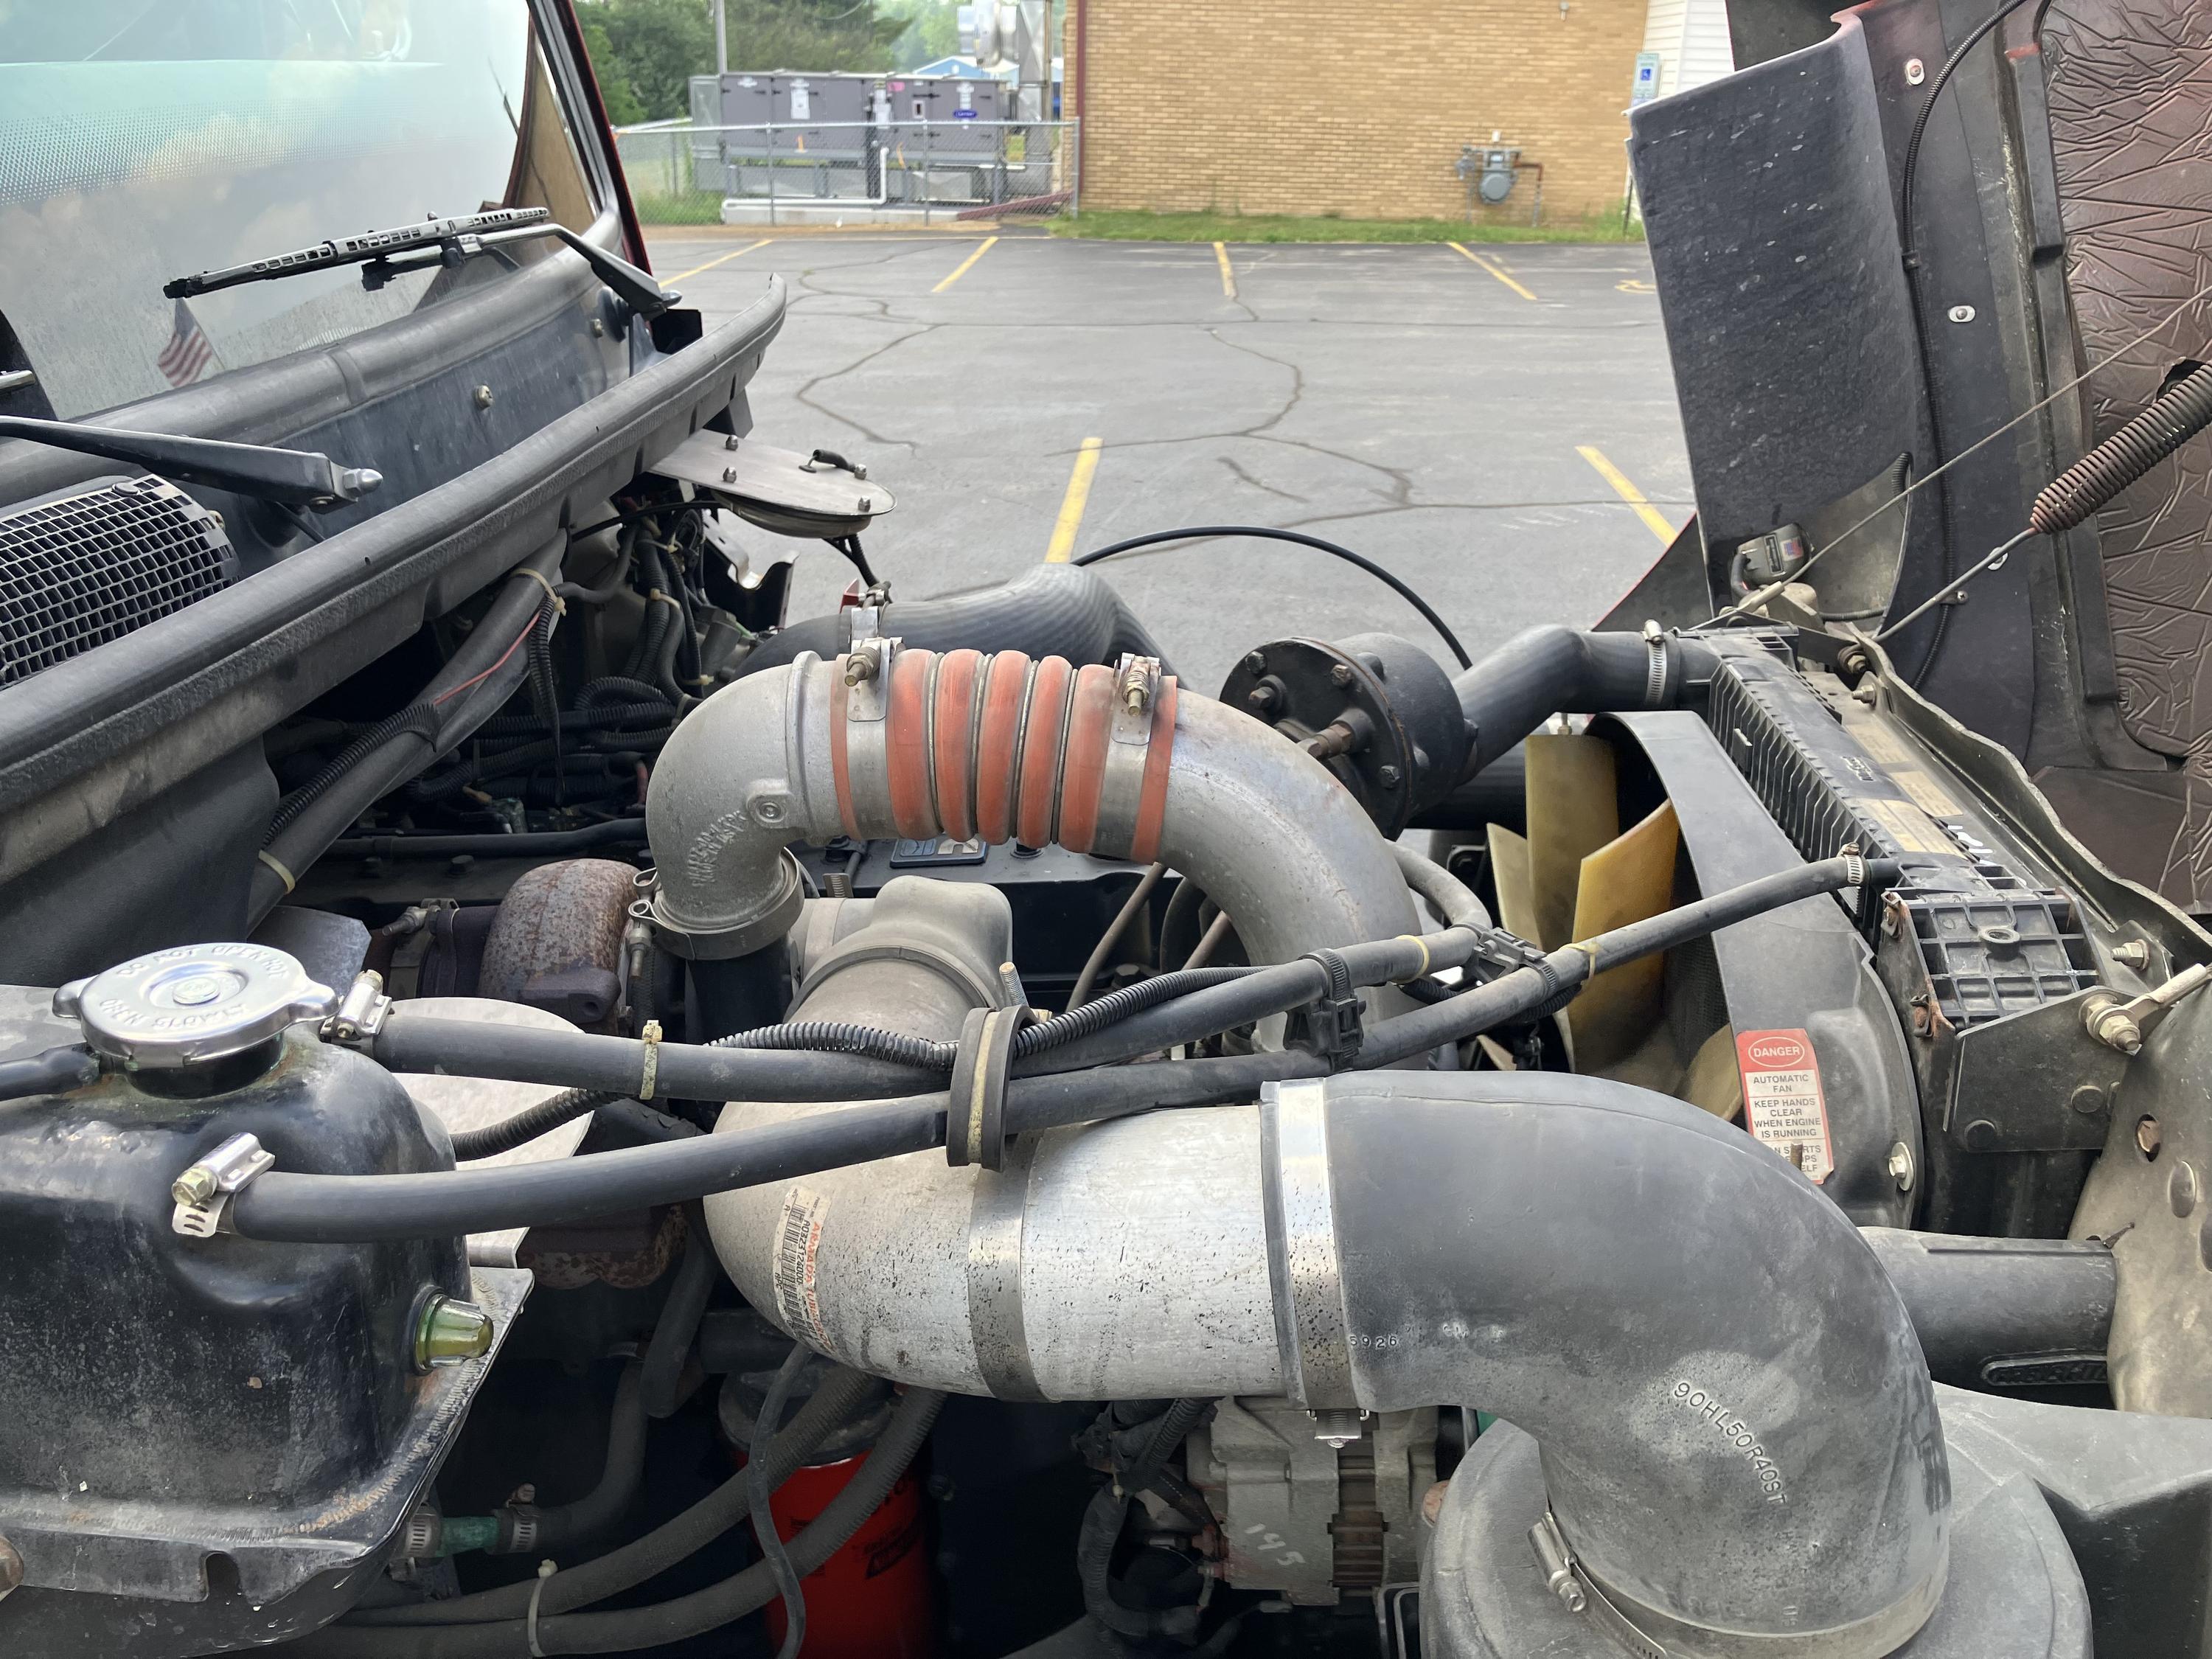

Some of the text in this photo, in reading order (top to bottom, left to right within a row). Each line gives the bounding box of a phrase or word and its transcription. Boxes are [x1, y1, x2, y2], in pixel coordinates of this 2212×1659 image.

[211, 945, 263, 961] OPEN
[1753, 1046, 1800, 1057] DANGER
[1753, 1074, 1809, 1084] AUTOMATIC
[1754, 1098, 1815, 1107] KEEP HANDS
[1770, 1109, 1802, 1117] CLEAR
[1754, 1118, 1821, 1127] WHEN ENGINE
[1773, 1129, 1817, 1138] RUNNING
[1784, 1145, 1821, 1154] SRTS
[1784, 1155, 1818, 1163] SPS
[805, 1221, 821, 1283] ARMADA
[775, 1272, 783, 1290] APC
[1673, 1382, 1787, 1505] 90HL50R40ST
